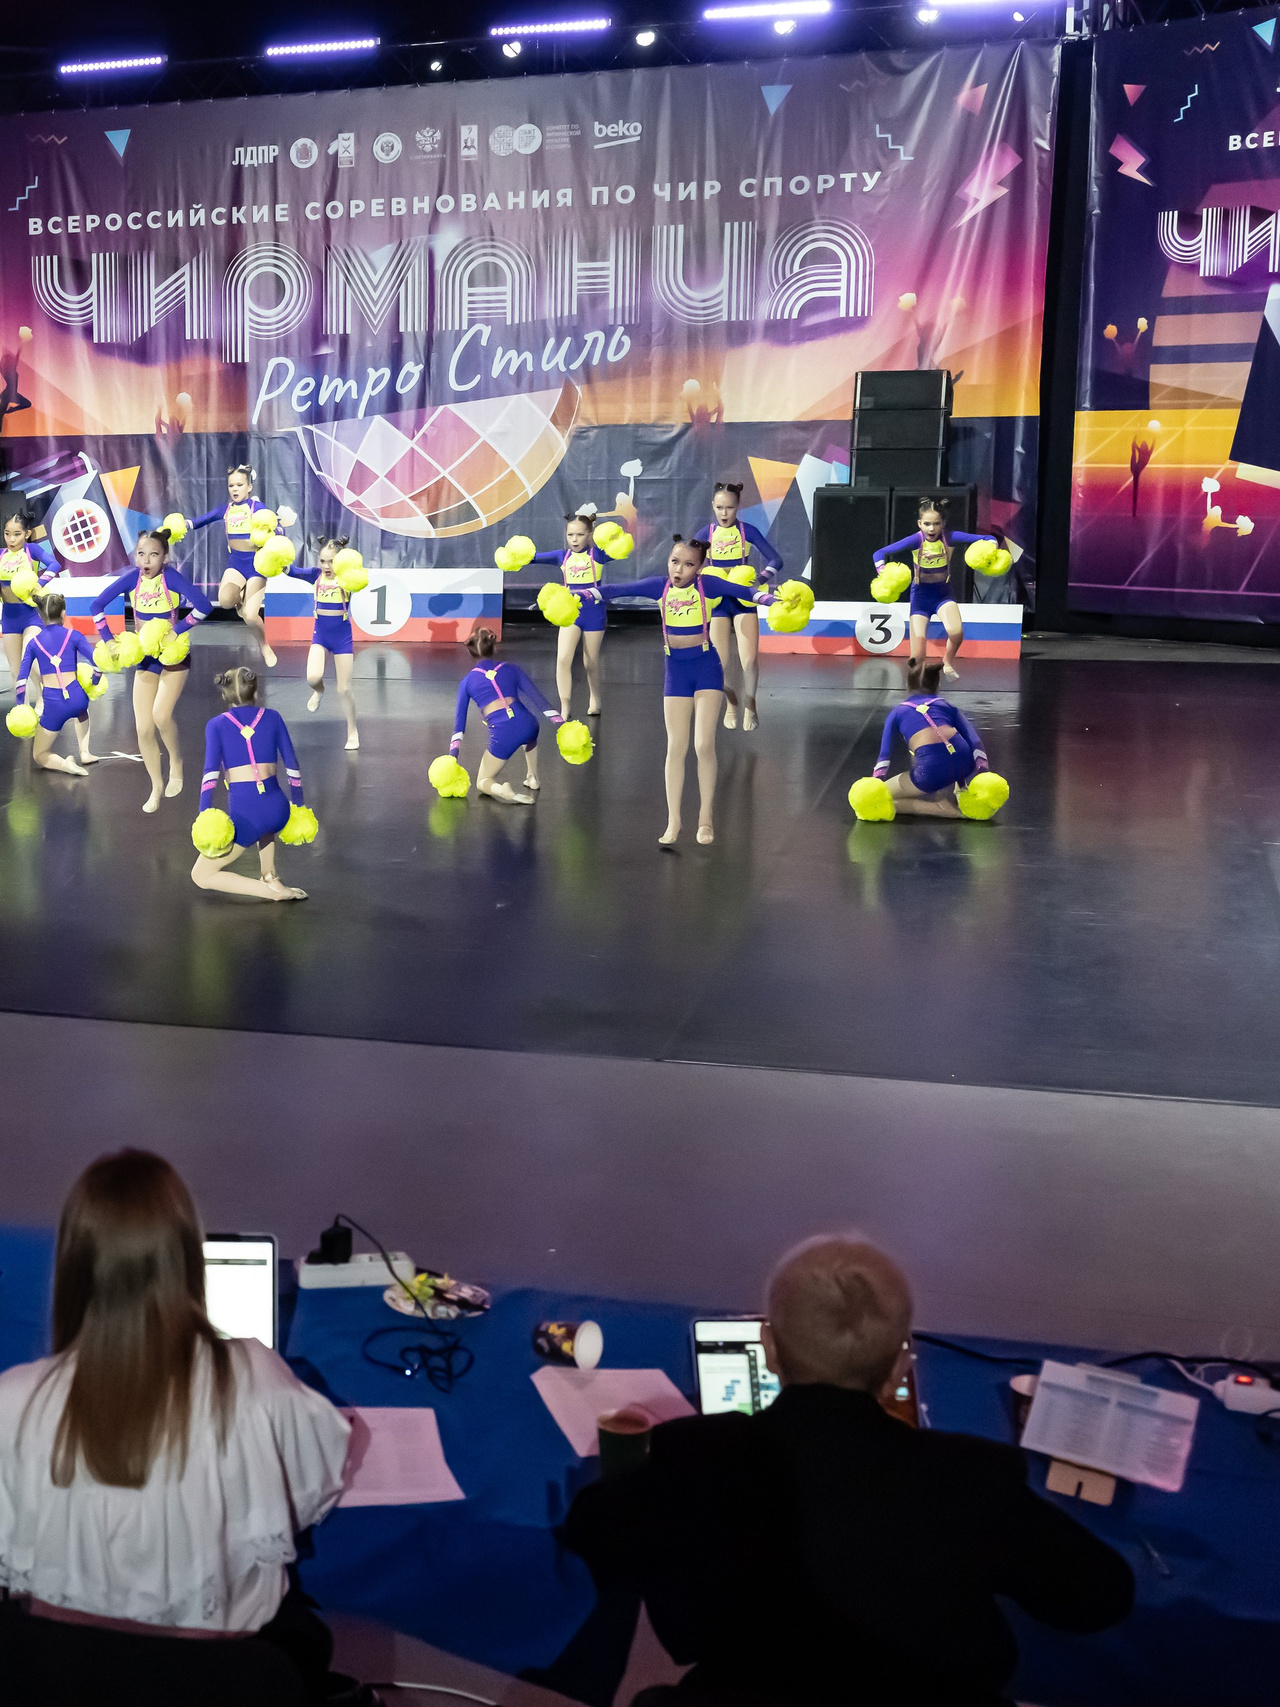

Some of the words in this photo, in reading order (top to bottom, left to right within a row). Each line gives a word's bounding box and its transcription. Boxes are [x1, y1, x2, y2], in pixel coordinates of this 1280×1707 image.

[594, 120, 642, 137] beko
[1228, 131, 1280, 151] ВСЕ
[232, 145, 279, 168] ЛДПР
[28, 202, 290, 235] ВСЕРОССИЙСКИЕ
[305, 186, 572, 220] СОРЕВНОВАНИЯ
[592, 184, 635, 206] ПО
[653, 179, 722, 202] ЧИР
[740, 170, 883, 198] СПОРТУ
[252, 356, 424, 425] Ретро
[448, 323, 632, 391] Стиль
[370, 585, 391, 624] 1
[868, 614, 892, 644] 3
